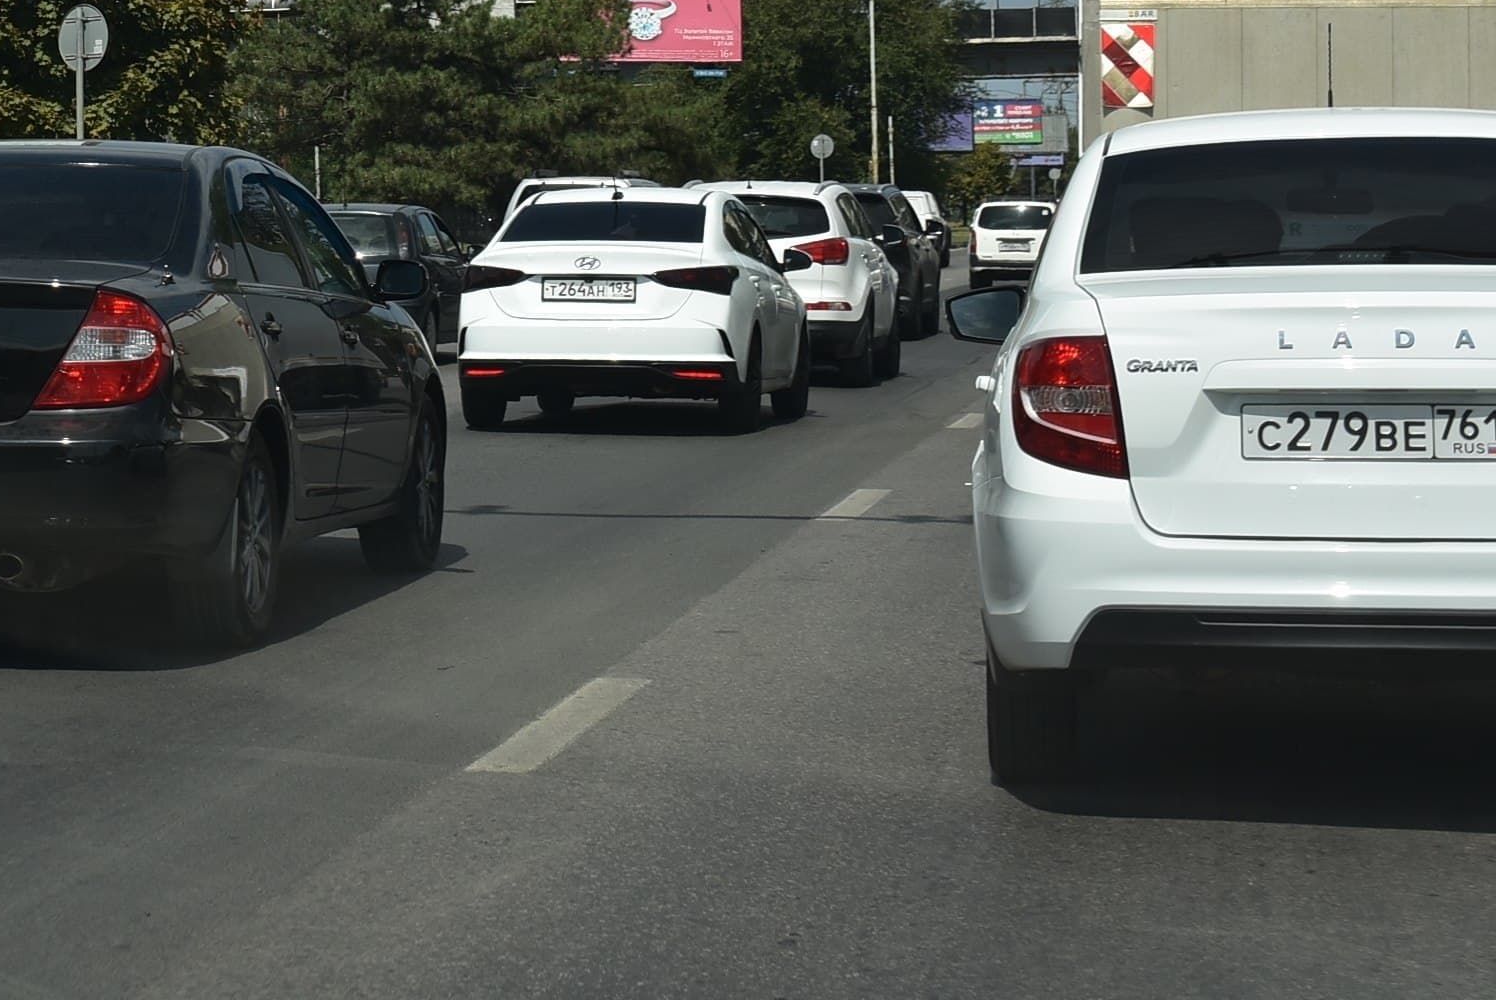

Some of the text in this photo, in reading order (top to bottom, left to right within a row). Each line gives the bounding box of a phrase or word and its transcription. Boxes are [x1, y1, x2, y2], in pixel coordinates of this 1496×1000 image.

[549, 282, 605, 297] Т264АН
[608, 282, 631, 294] 193
[1278, 329, 1476, 350] LADA
[1126, 358, 1199, 373] GRANTA
[1257, 410, 1427, 452] С279ВЕ
[1452, 442, 1486, 455] RUS
